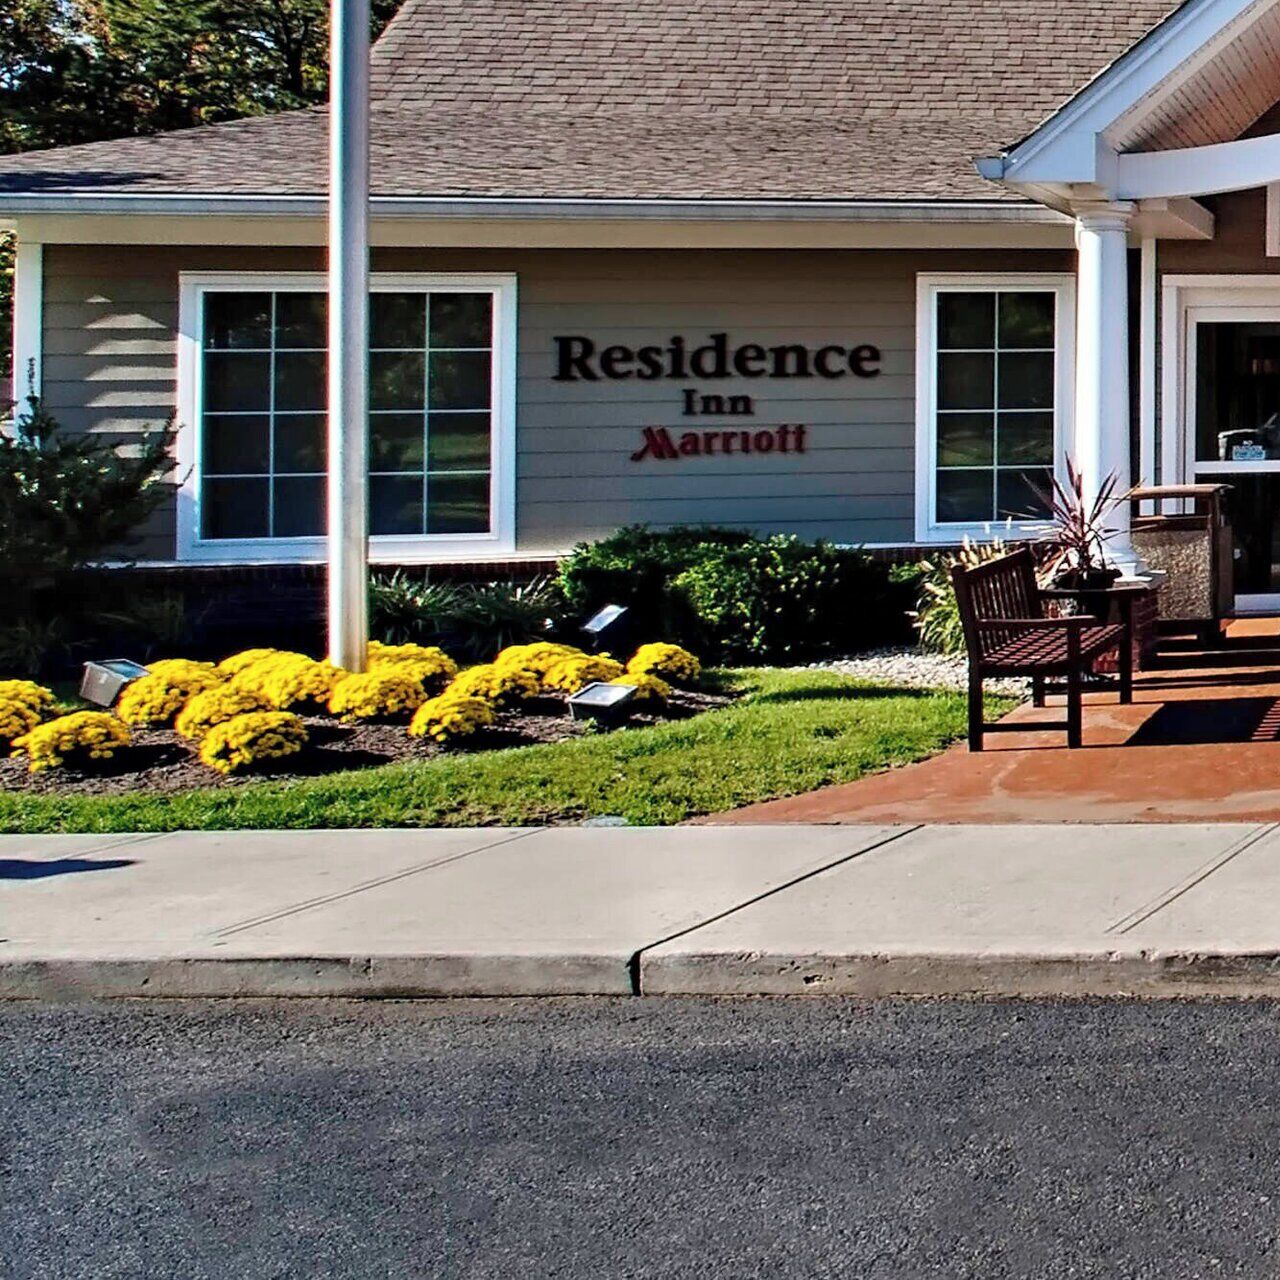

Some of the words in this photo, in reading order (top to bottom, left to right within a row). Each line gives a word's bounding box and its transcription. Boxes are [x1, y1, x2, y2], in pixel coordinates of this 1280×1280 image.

[551, 333, 882, 382] Residence
[682, 389, 754, 416] Inn
[631, 424, 808, 462] Marriott
